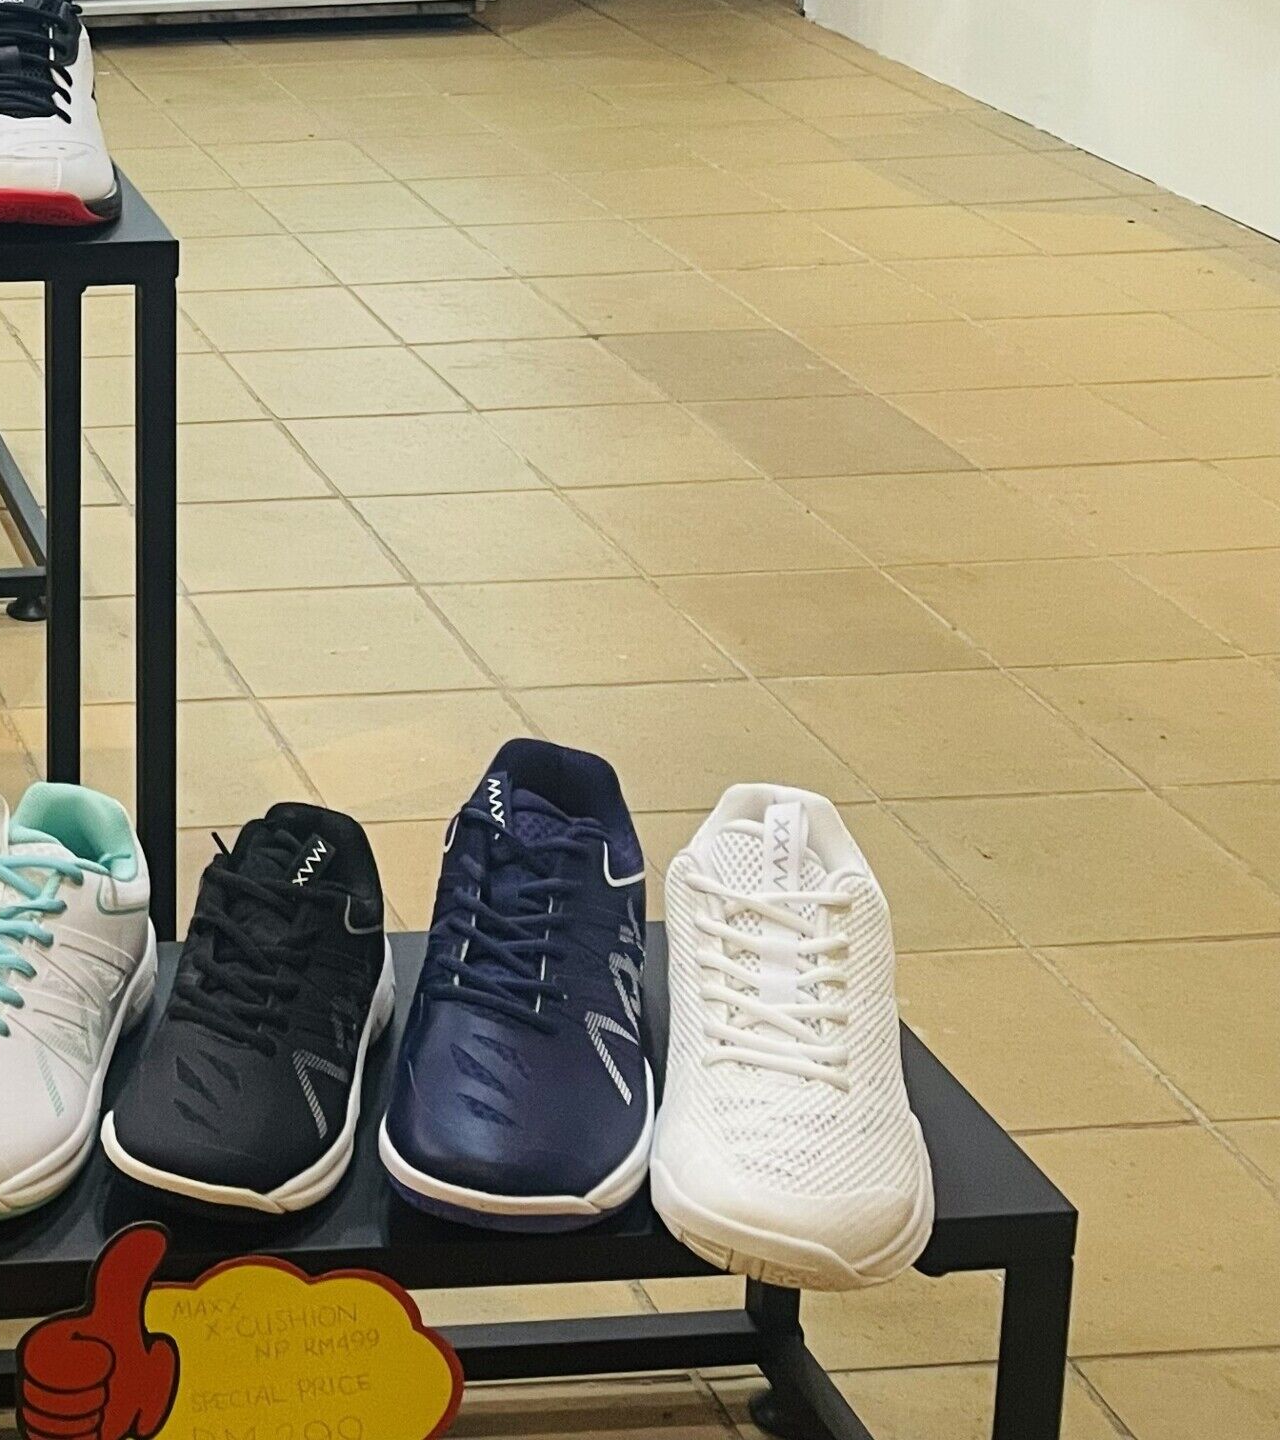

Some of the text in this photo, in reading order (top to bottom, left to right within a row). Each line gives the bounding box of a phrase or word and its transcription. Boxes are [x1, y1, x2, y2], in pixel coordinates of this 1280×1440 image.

[205, 1303, 359, 1342] X-CUSHION
[191, 1372, 371, 1413] SPECIAL PRICE
